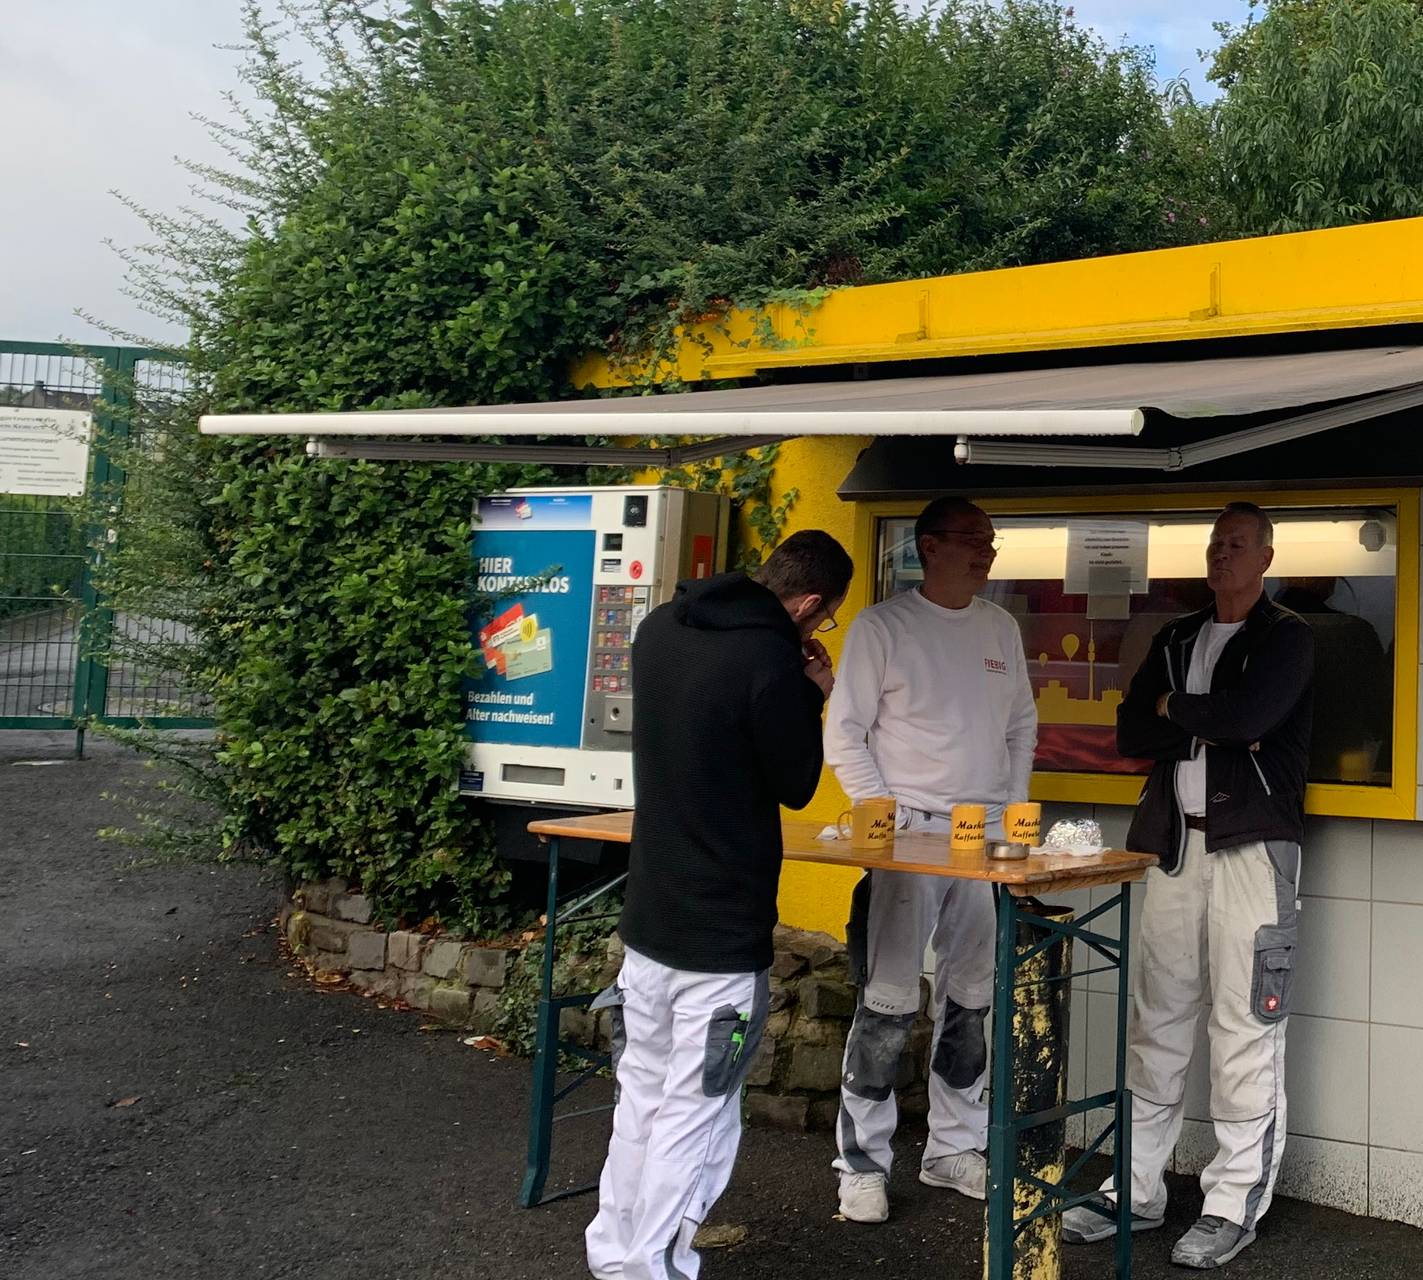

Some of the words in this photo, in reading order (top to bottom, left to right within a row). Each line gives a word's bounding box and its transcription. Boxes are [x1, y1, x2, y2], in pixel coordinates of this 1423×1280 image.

[479, 557, 512, 574] HIER
[477, 576, 570, 594] KONTATLOS
[468, 690, 513, 705] Bezahlen
[514, 693, 534, 705] und
[466, 708, 489, 721] Alter
[492, 710, 554, 725] nachweisen!
